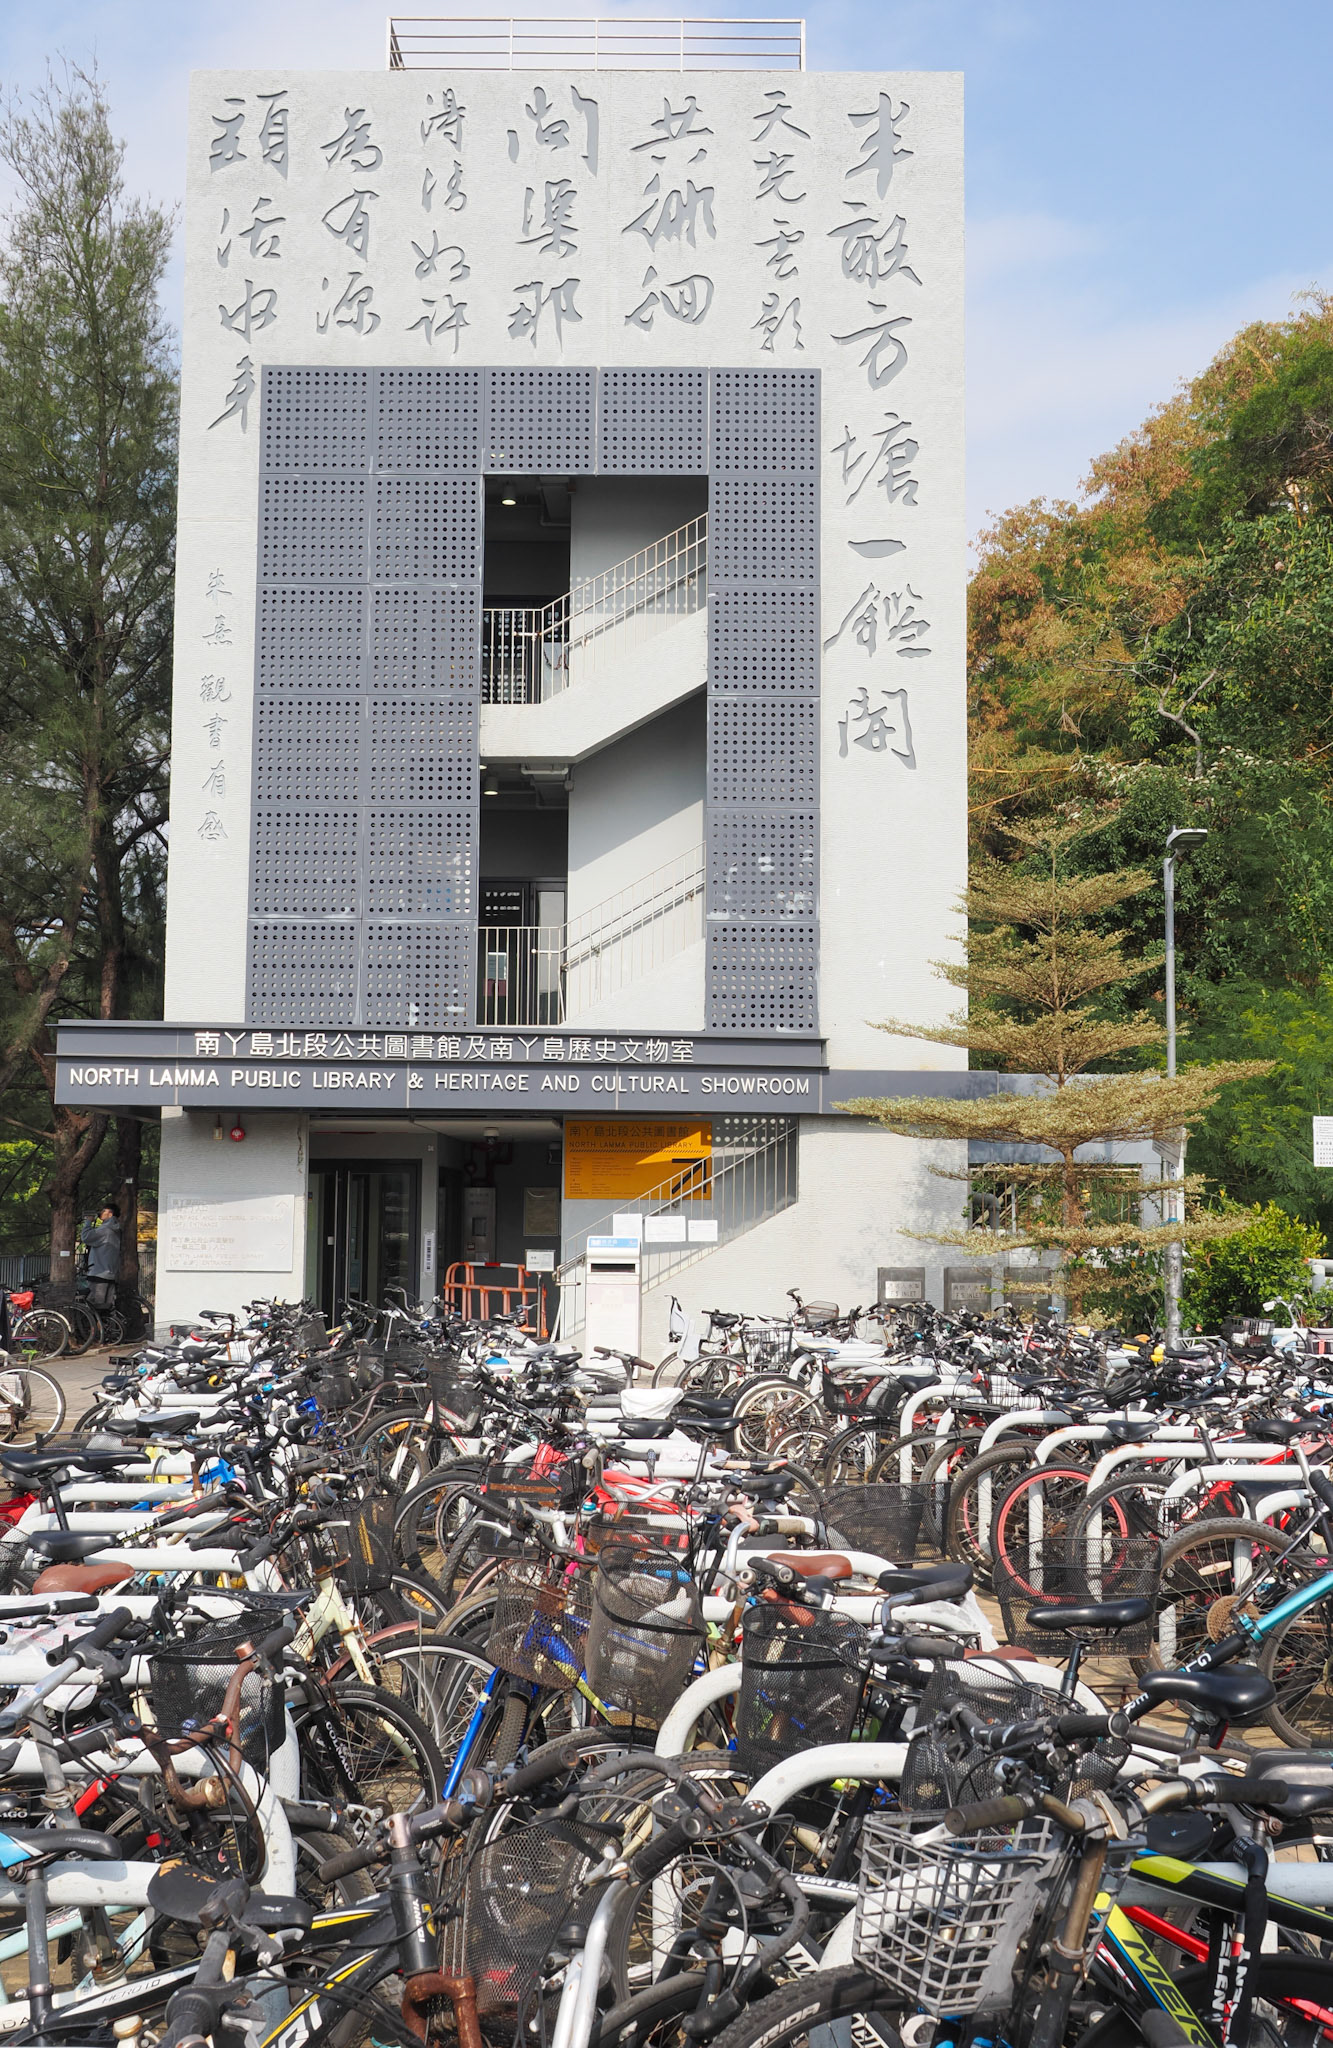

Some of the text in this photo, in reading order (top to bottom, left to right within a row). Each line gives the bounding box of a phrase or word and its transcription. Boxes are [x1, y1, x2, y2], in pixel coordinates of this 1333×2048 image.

[195, 1032, 695, 1063] 南丫島北段公共圖書館及南丫島歷史文物室
[69, 1067, 810, 1095] NORTH LAMMA PUBLIC LIBRARY & HERITAGE AND CULTURAL SHOWROOM
